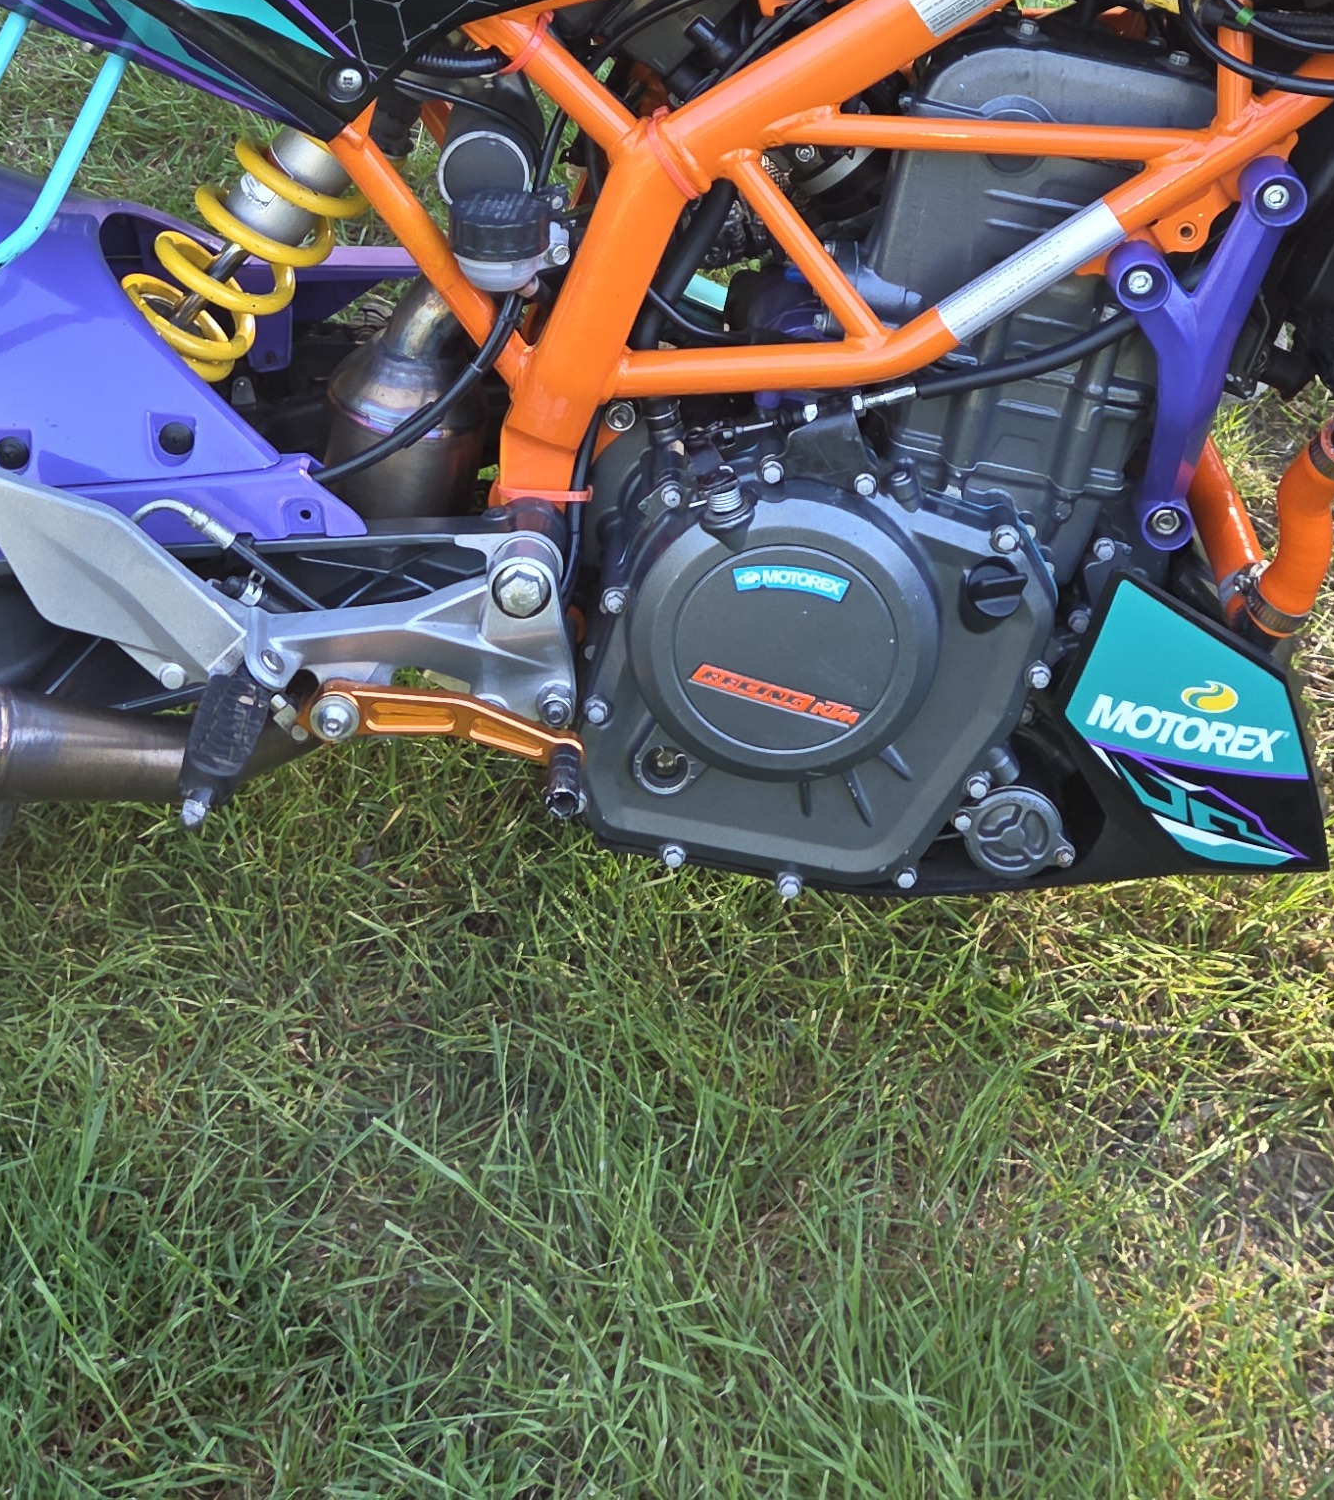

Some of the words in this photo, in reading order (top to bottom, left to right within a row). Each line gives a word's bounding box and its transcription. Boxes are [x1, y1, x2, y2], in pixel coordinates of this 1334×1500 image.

[762, 570, 845, 595] MOTOREX
[701, 669, 804, 709] RACING
[810, 700, 861, 725] KTM
[1085, 693, 1285, 763] MOTOREX
